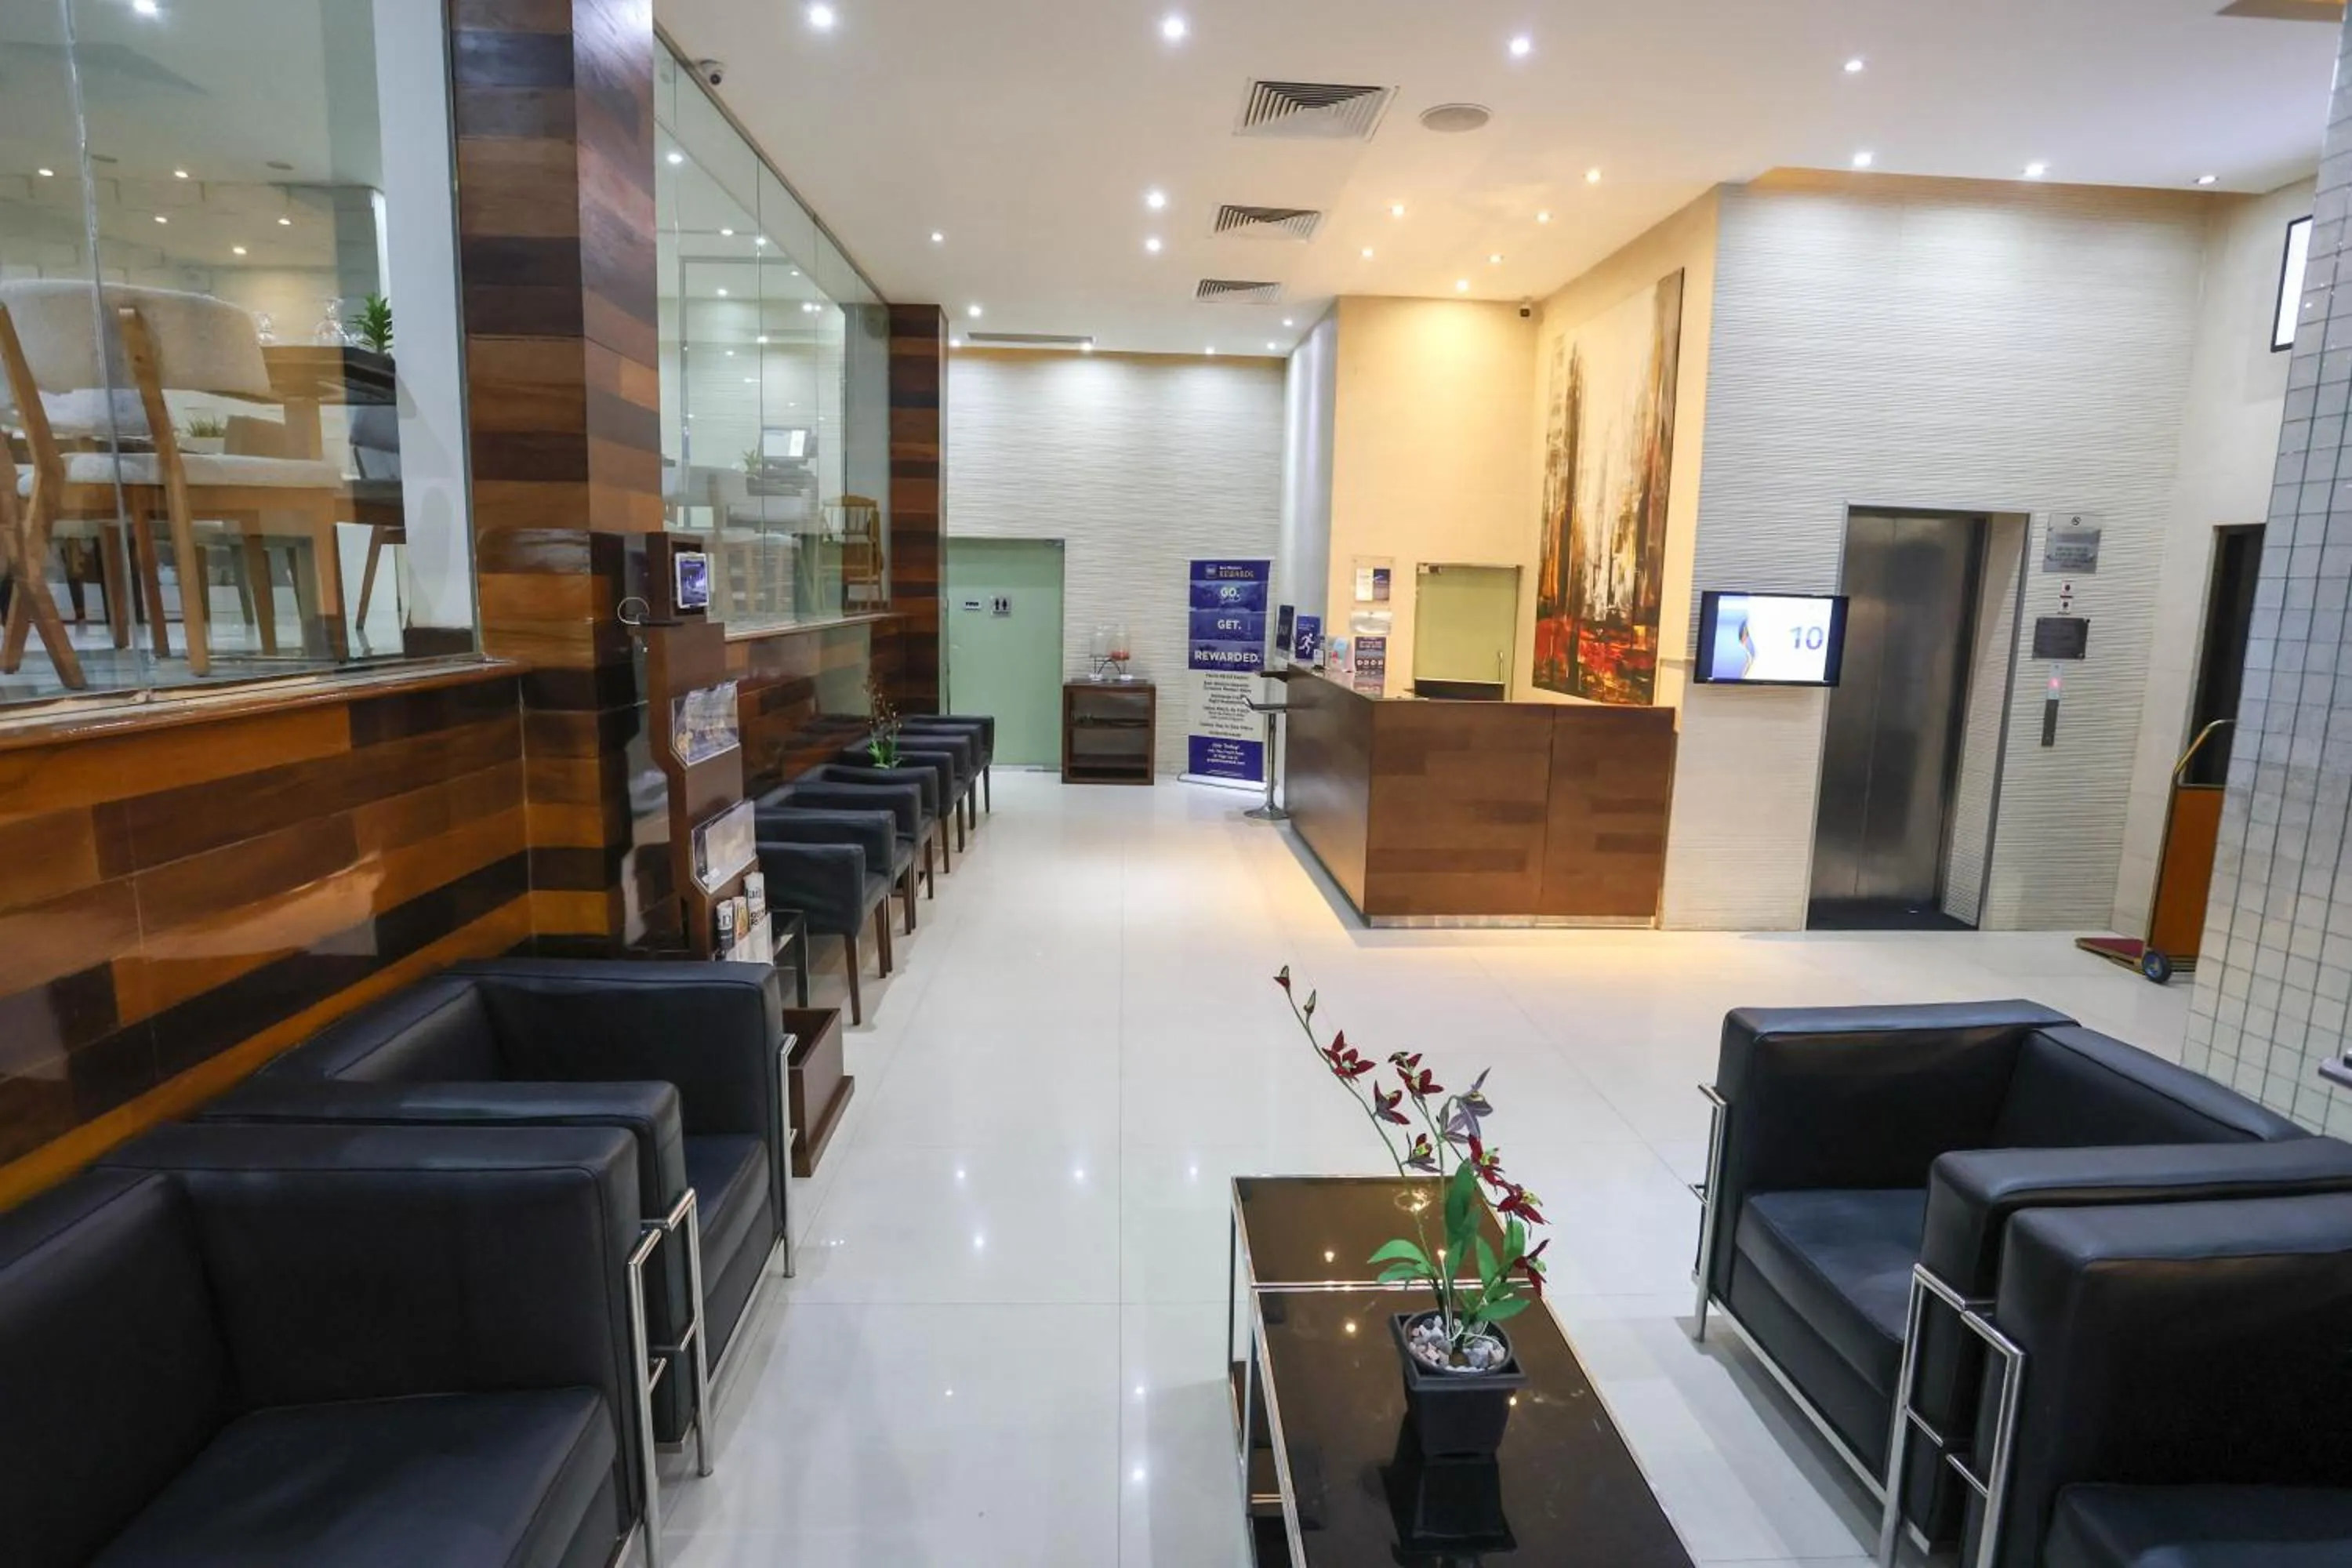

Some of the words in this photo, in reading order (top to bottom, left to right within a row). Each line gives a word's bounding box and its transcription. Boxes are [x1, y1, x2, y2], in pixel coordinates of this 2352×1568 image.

[1220, 586, 1240, 598] GO.
[1217, 619, 1242, 630] GET.
[1790, 626, 1824, 651] 10
[1194, 650, 1261, 663] REWARDED.
